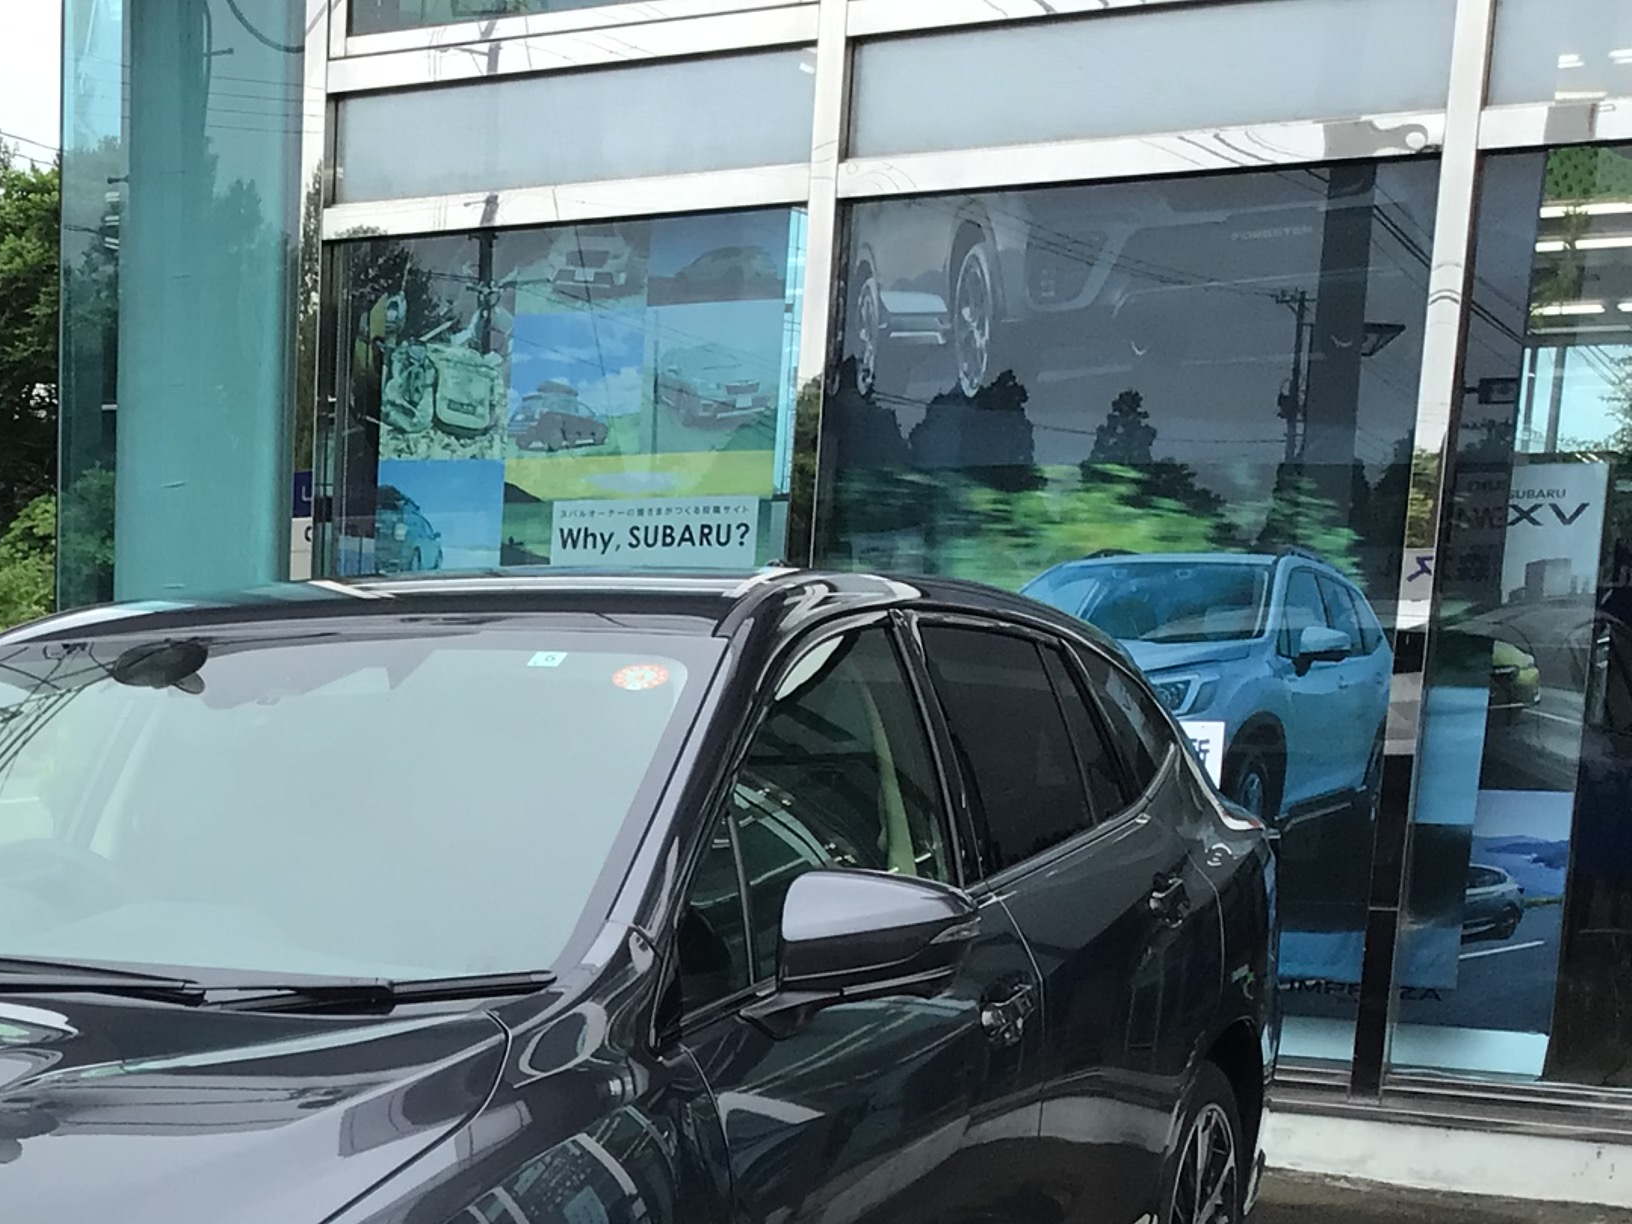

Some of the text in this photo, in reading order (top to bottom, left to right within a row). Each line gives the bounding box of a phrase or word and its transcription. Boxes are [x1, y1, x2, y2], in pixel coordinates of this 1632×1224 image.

[1508, 488, 1567, 500] SUBARU
[1506, 502, 1591, 526] XV
[559, 522, 751, 555] Why, SUBARU?
